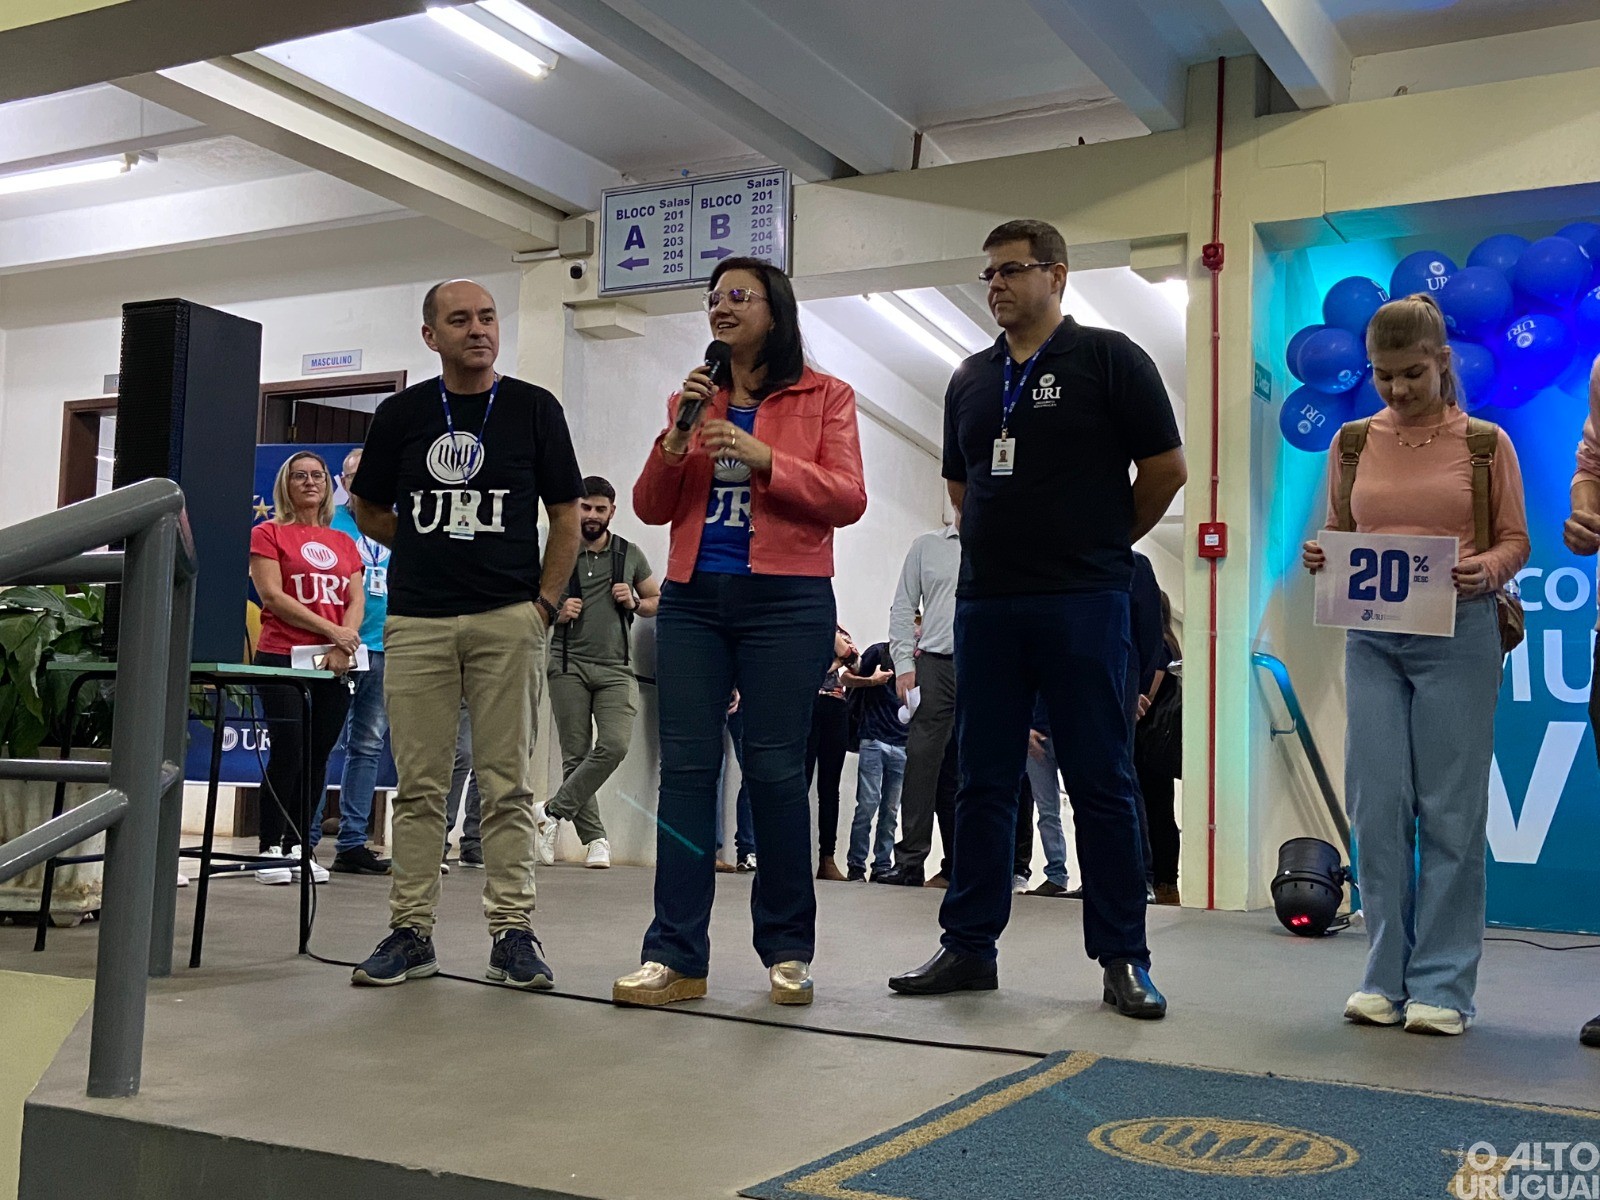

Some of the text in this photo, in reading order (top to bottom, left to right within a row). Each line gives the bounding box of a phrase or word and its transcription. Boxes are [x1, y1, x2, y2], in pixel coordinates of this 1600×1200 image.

[747, 177, 779, 189] Salas
[701, 193, 742, 209] BLOCO
[752, 190, 772, 202] 201
[659, 198, 690, 209] Salas
[751, 204, 773, 215] 202
[616, 205, 655, 220] BLOCO
[664, 210, 684, 221] 201
[663, 223, 684, 234] 202
[710, 213, 731, 240] B
[751, 217, 772, 229] 203
[624, 225, 646, 251] A
[663, 236, 684, 247] 203
[750, 231, 773, 242] 204
[663, 249, 684, 261] 204
[750, 244, 773, 256] 205
[663, 263, 684, 274] 205
[311, 355, 353, 367] MASCULINO
[1032, 386, 1062, 401] URI
[1300, 404, 1326, 428] URI
[410, 489, 511, 534] URI
[1348, 547, 1430, 603] 20 %
